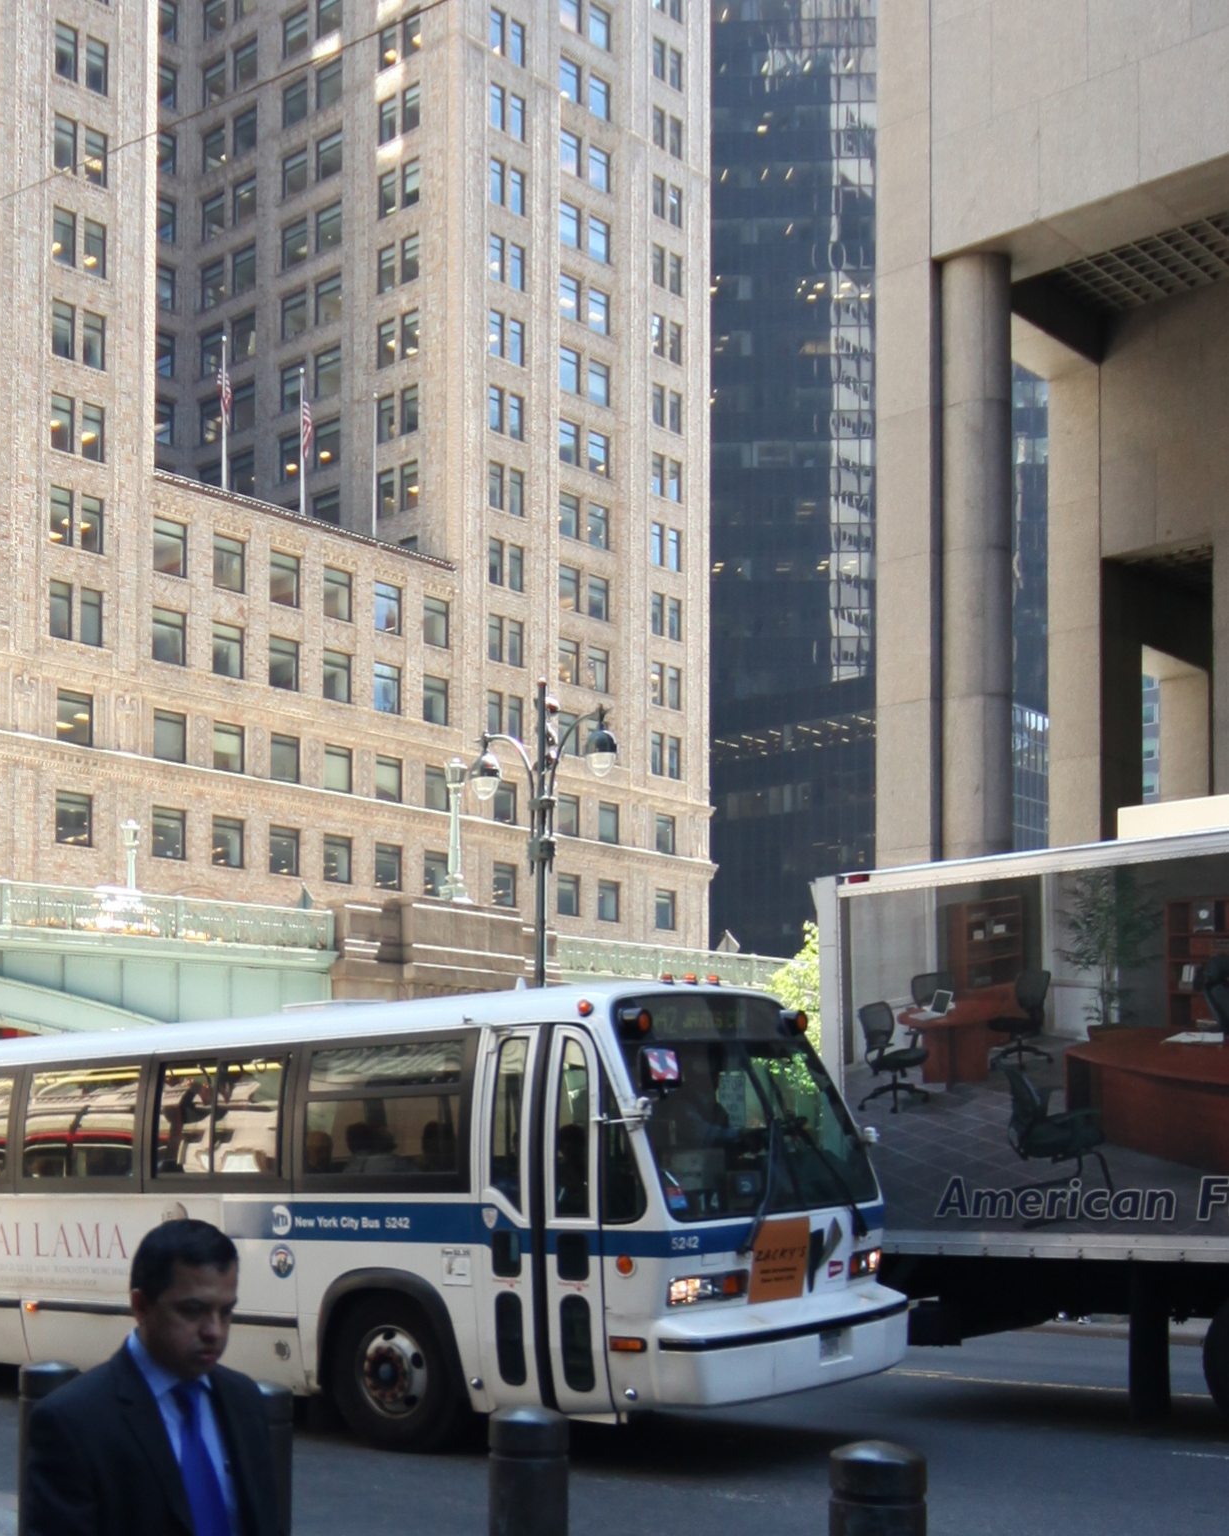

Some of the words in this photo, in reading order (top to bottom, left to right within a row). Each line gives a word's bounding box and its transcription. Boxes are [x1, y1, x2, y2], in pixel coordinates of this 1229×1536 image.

[935, 1175, 1177, 1221] American
[1196, 1175, 1229, 1222] F
[294, 1216, 315, 1228] New
[316, 1216, 339, 1228] York
[340, 1216, 359, 1231] City
[361, 1216, 380, 1229] Bus
[384, 1217, 410, 1229] 5242
[34, 1222, 129, 1260] LAMA
[671, 1235, 700, 1250] 5242
[754, 1245, 807, 1263] ZACKY'S
